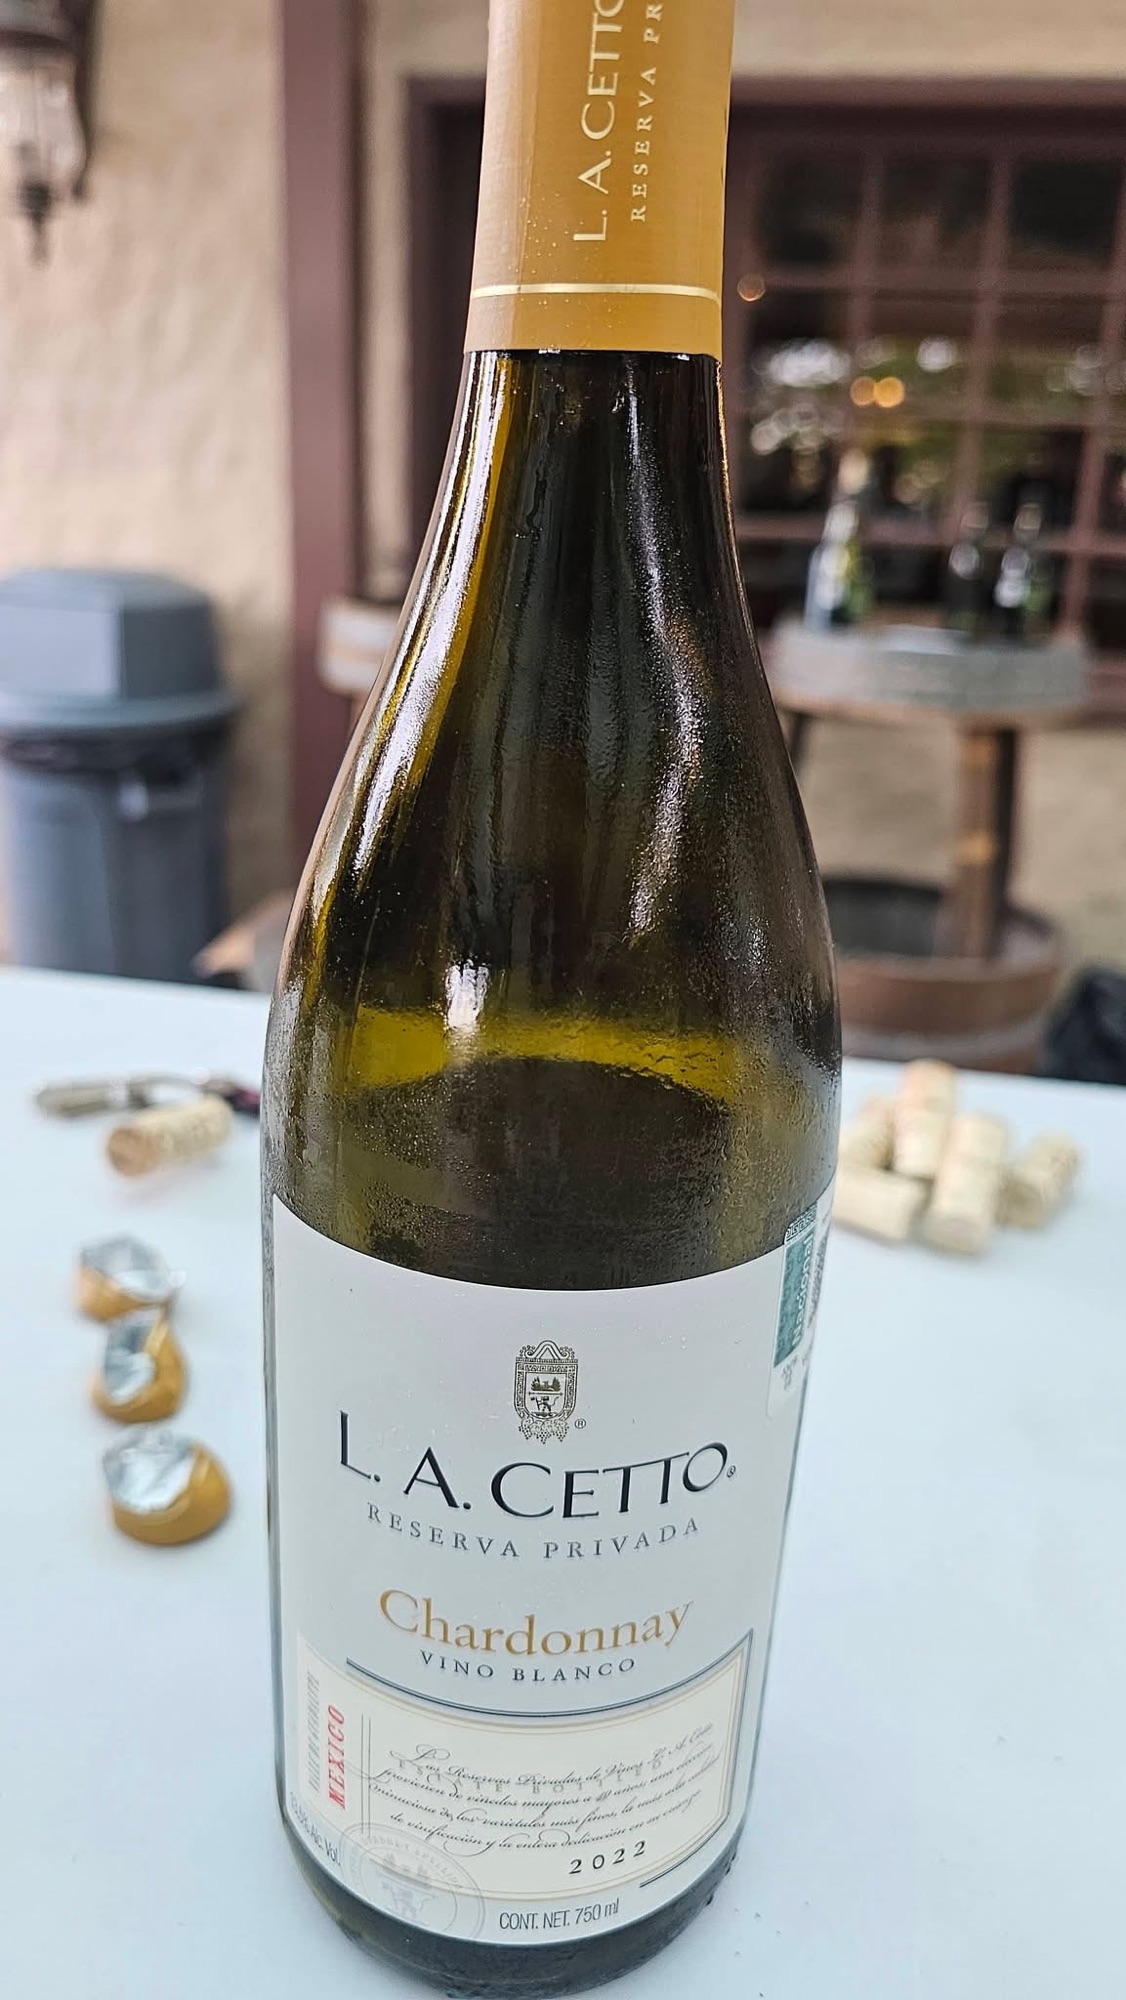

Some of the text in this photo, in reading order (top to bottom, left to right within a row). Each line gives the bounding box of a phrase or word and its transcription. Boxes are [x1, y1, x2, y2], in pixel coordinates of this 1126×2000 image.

[630, 67, 657, 223] RESERVA
[578, 150, 613, 194] A.
[573, 209, 607, 241] L.
[340, 1410, 381, 1483] L.
[403, 1446, 472, 1510] A.
[367, 1502, 699, 1559] RESERVA PRIVADA
[379, 1589, 694, 1656] Chardonnay
[419, 1650, 636, 1682] VINO BLANCO
[328, 1704, 345, 1810] MEXICO
[370, 1768, 445, 1796] provienen
[445, 1766, 510, 1785] Reservas
[515, 1771, 581, 1787] Privadas
[585, 1767, 601, 1781] de
[532, 1758, 662, 1795] BOTTLED
[390, 1812, 405, 1823] de
[569, 1840, 646, 1875] 2022
[500, 1898, 620, 1930] CONT. NET. 750 ml
